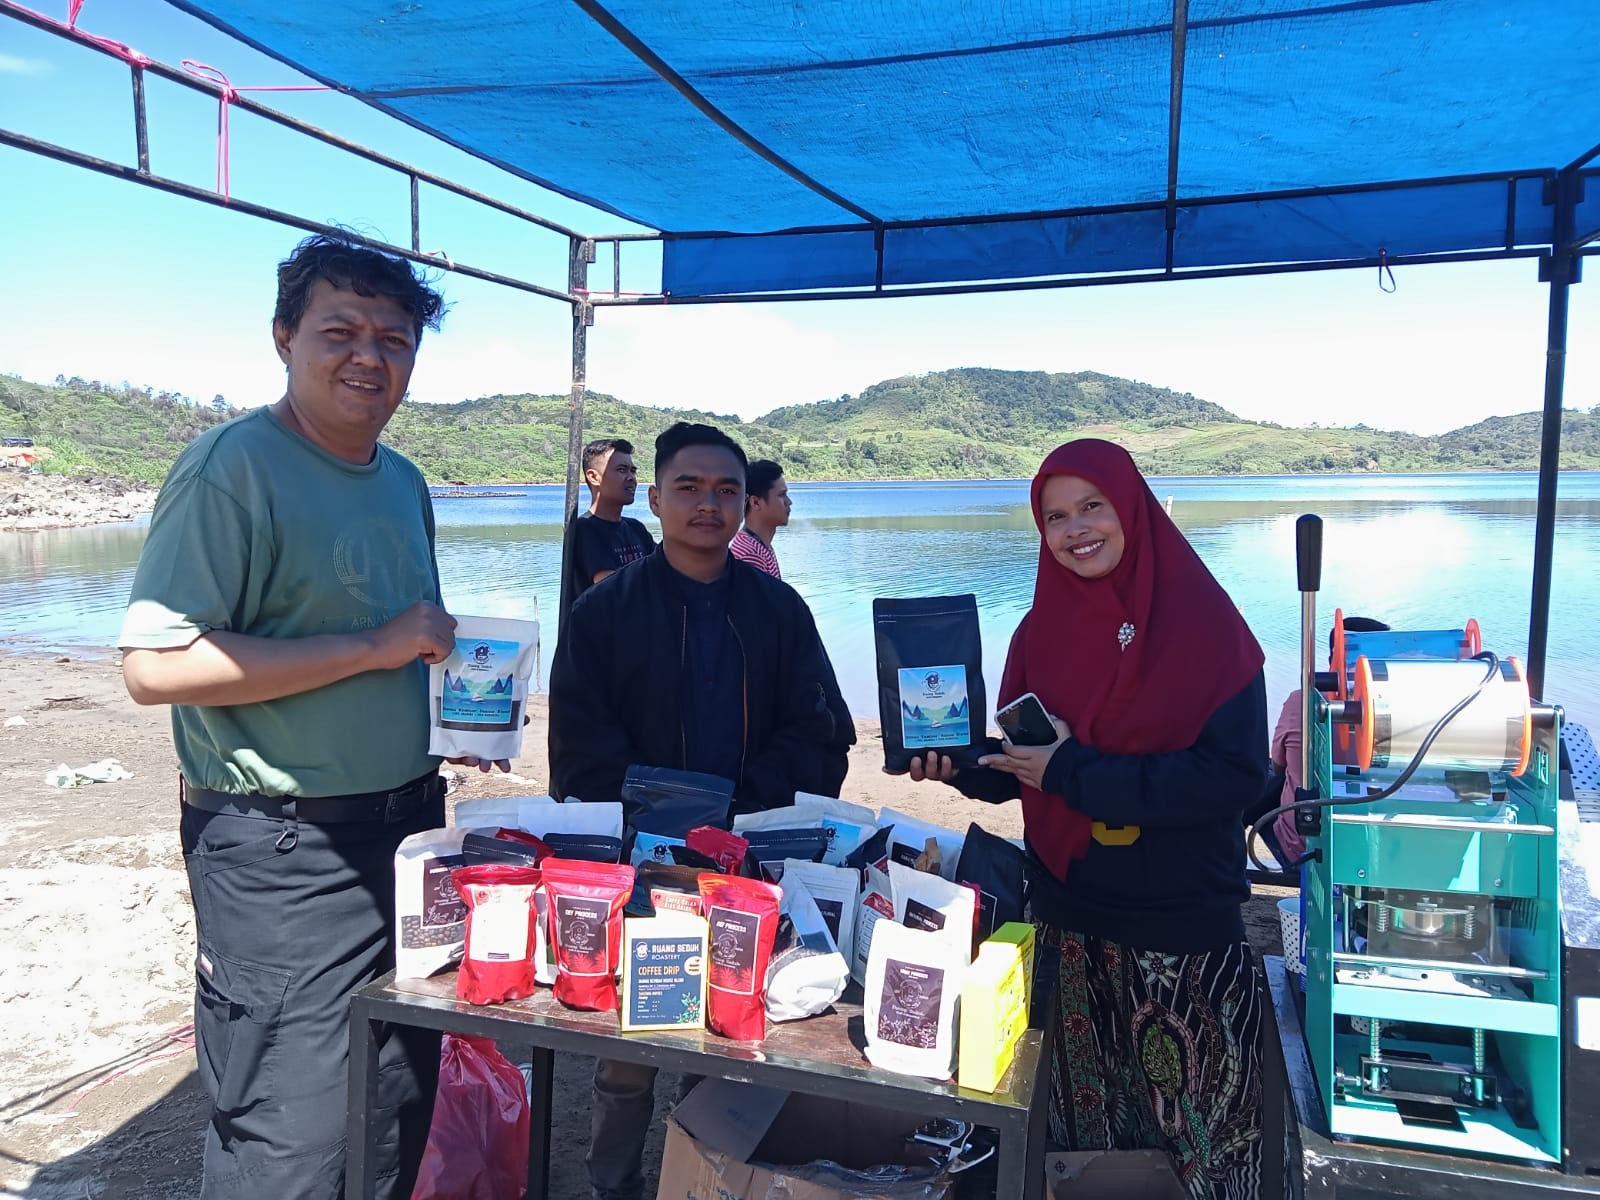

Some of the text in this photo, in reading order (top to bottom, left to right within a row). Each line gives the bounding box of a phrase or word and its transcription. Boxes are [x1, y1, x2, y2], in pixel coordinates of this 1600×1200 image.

[652, 943, 700, 953] RUANG SEDUH
[638, 966, 662, 976] COFFEE
[664, 965, 680, 975] DRIP
